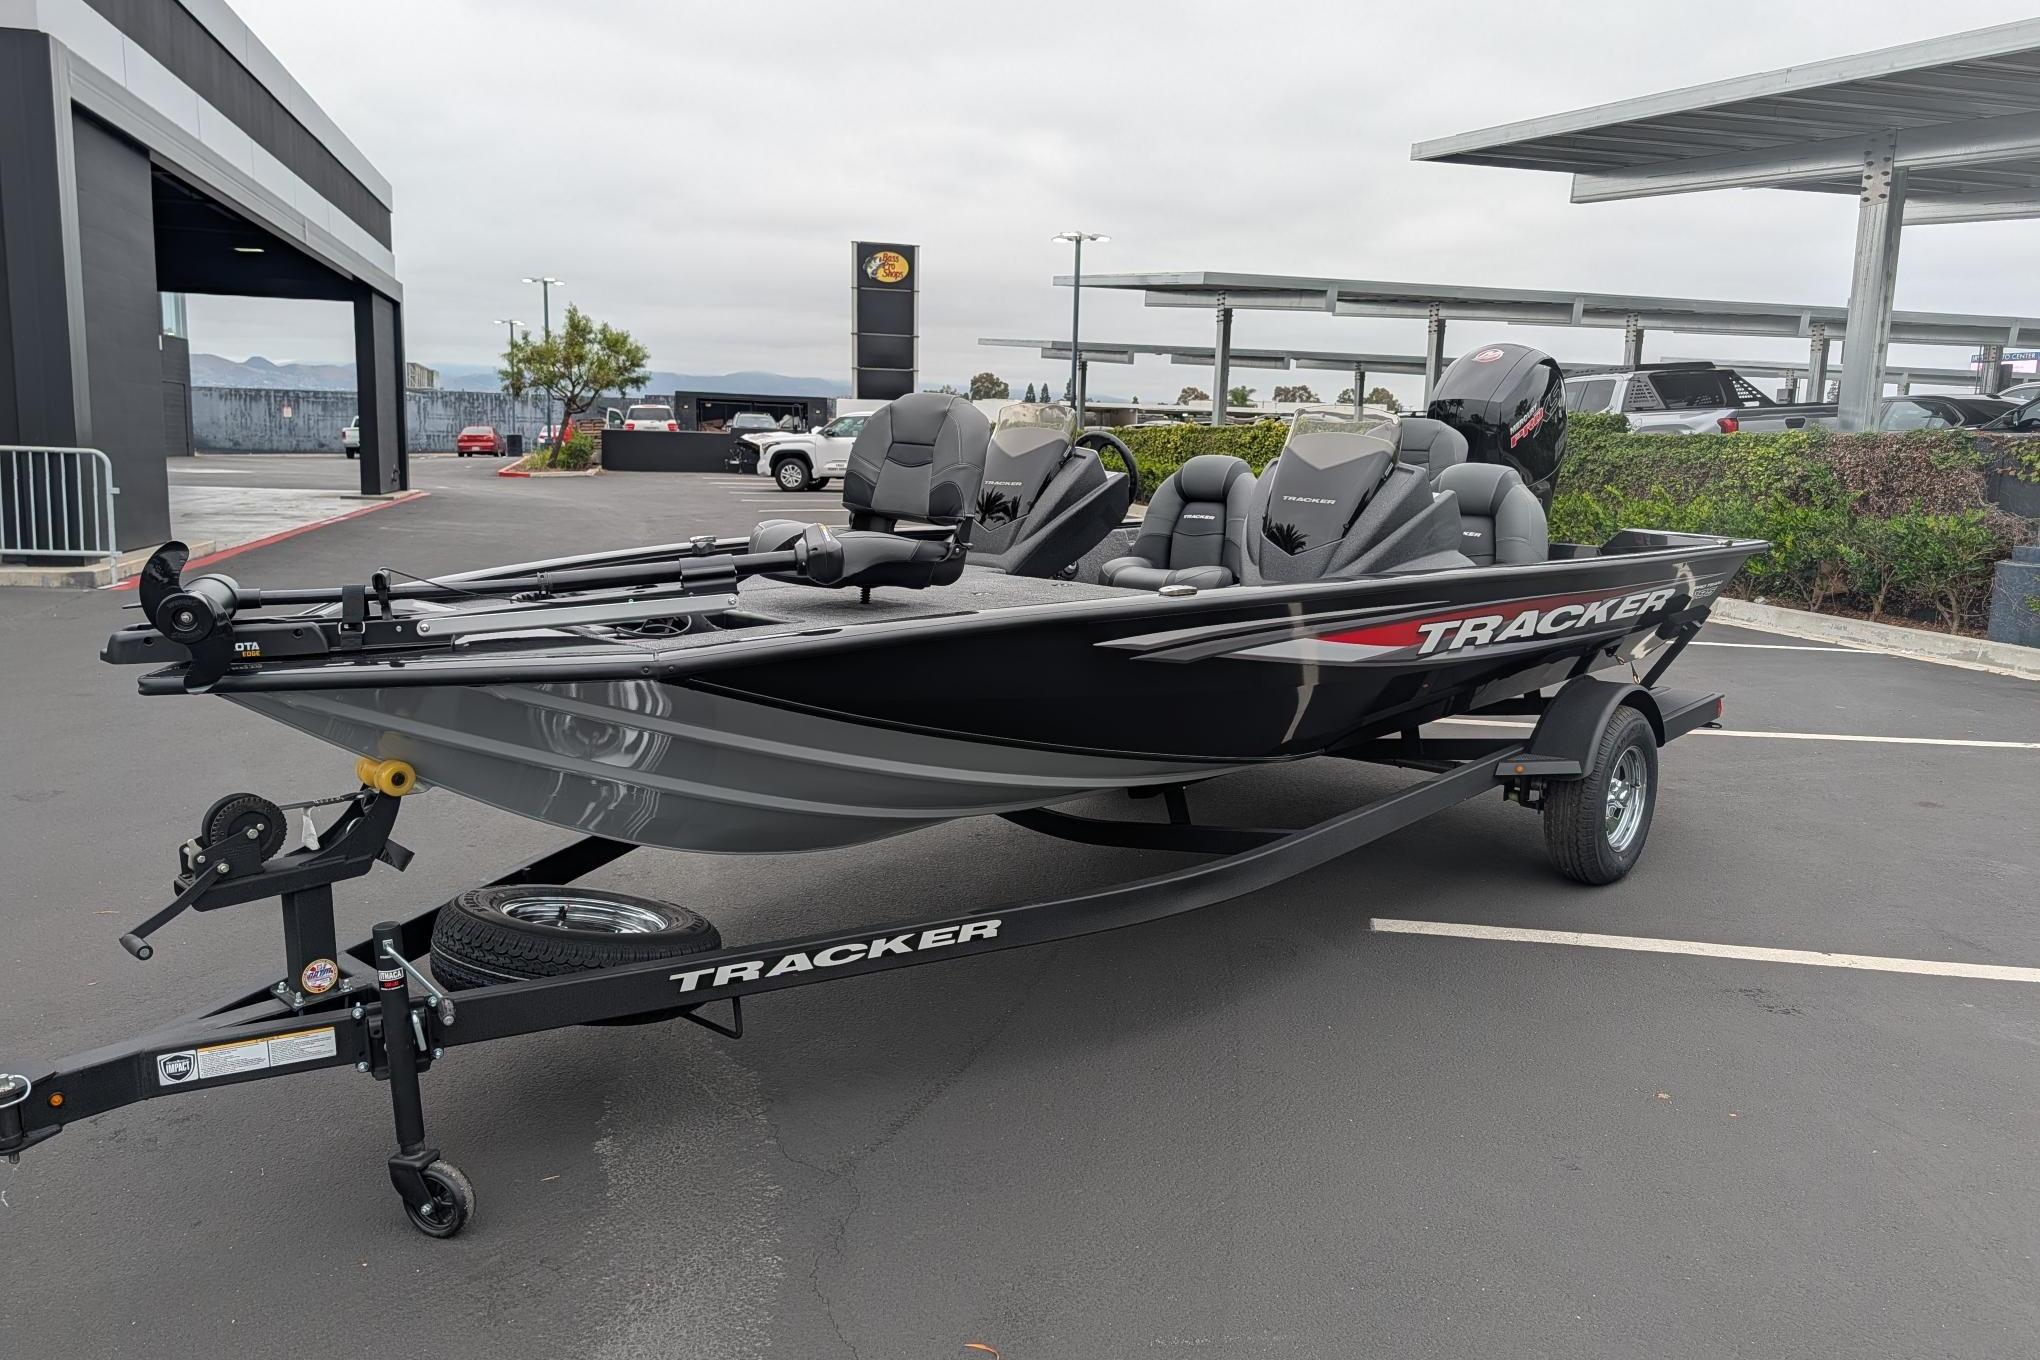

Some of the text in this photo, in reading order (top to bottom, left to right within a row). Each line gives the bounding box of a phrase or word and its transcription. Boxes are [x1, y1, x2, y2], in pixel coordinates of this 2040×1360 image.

[882, 253, 900, 263] Bass
[882, 269, 904, 280] Shops
[1282, 495, 1337, 505] TRACKER
[1417, 588, 1676, 655] TRACKER
[234, 641, 260, 652] OTA
[669, 919, 1002, 993] TRACKER
[165, 1061, 191, 1074] IMPACT
